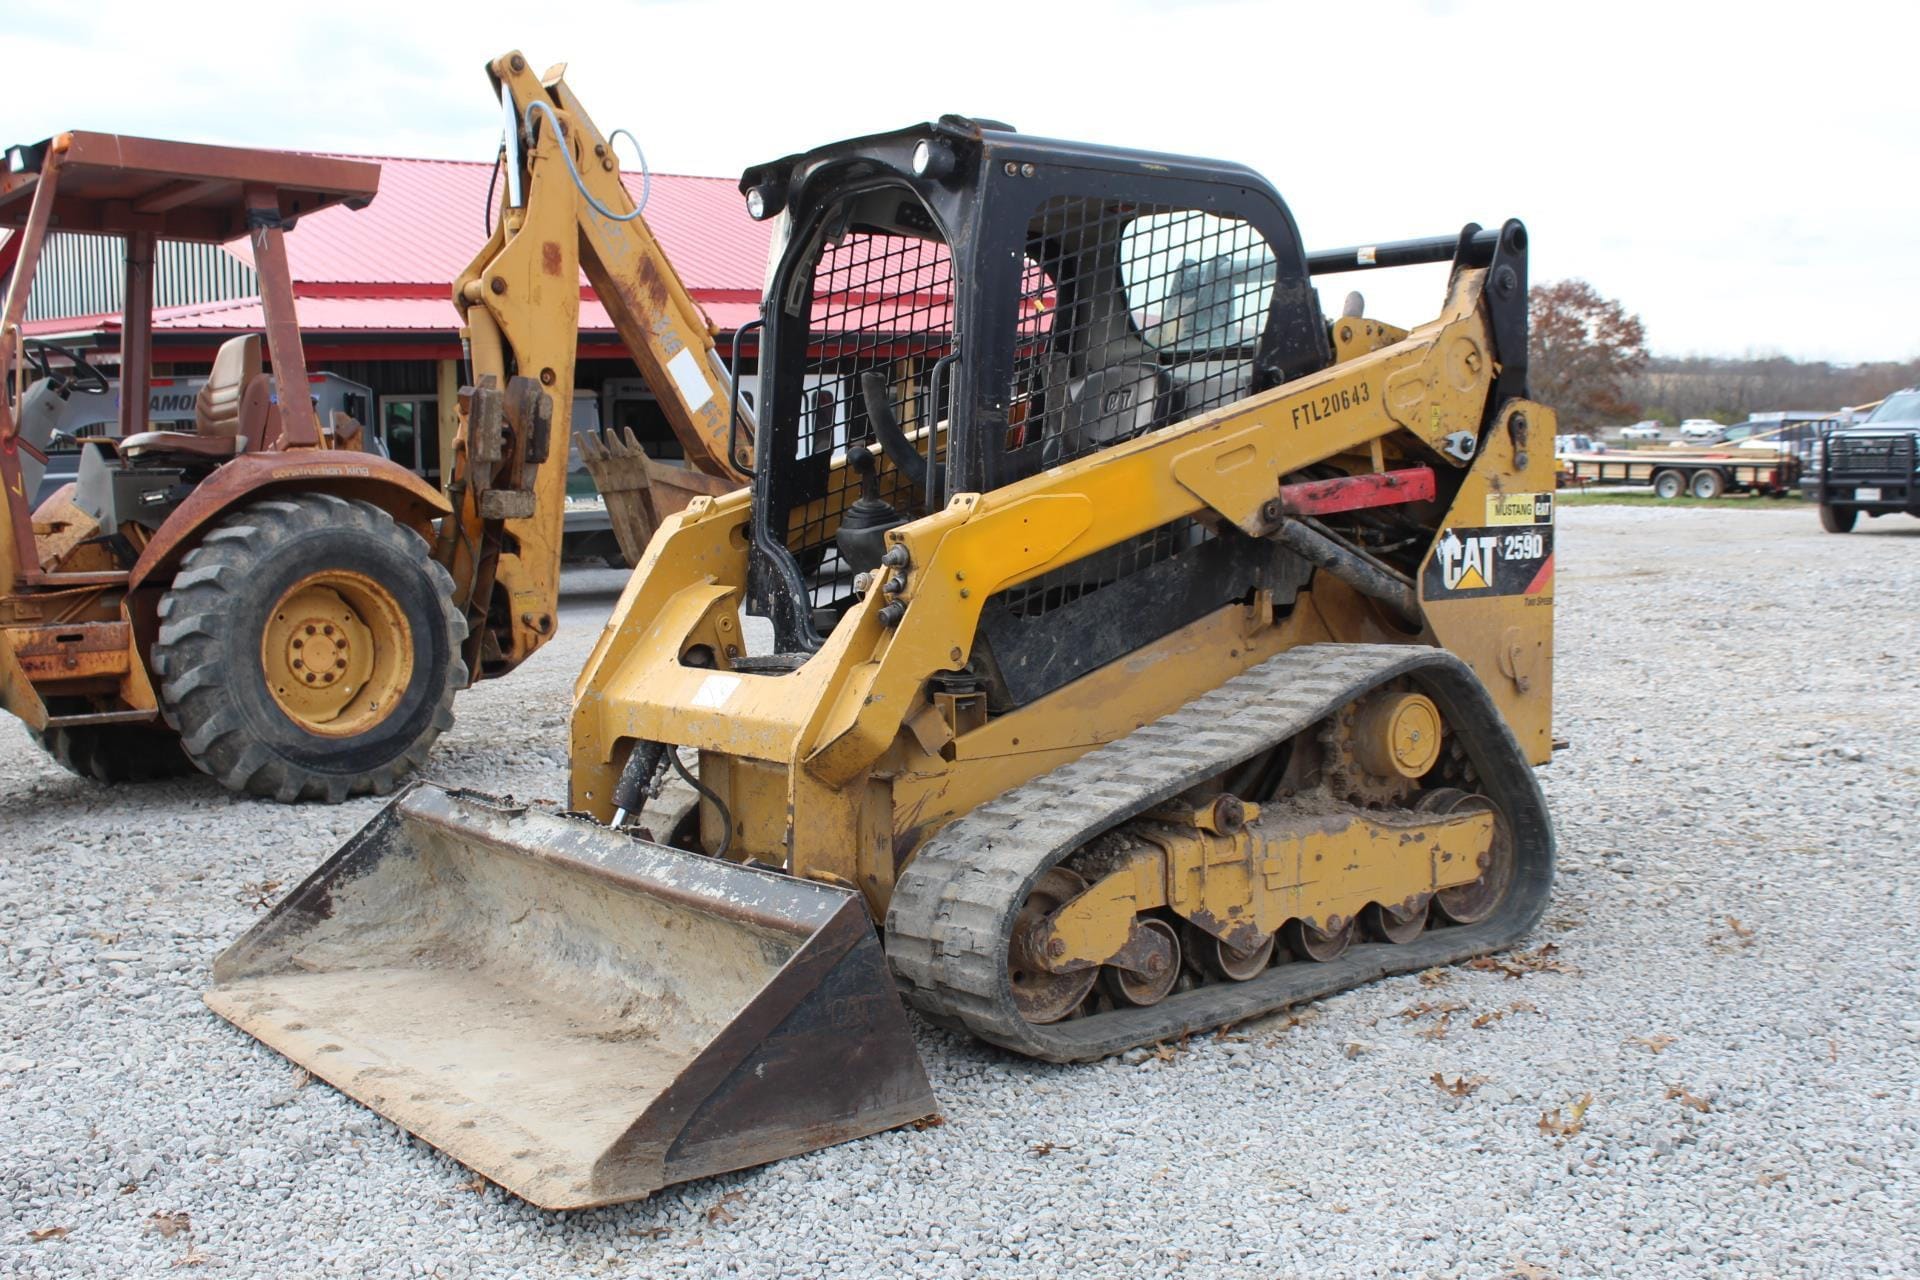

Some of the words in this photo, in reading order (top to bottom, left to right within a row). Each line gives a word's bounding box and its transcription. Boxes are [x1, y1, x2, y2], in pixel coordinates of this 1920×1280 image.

[1291, 382, 1369, 430] FTL20643
[272, 467, 341, 479] construction
[345, 465, 369, 477] king
[1495, 503, 1532, 516] MUSTANG
[1443, 536, 1497, 590] CAT
[1504, 534, 1543, 560] 259D
